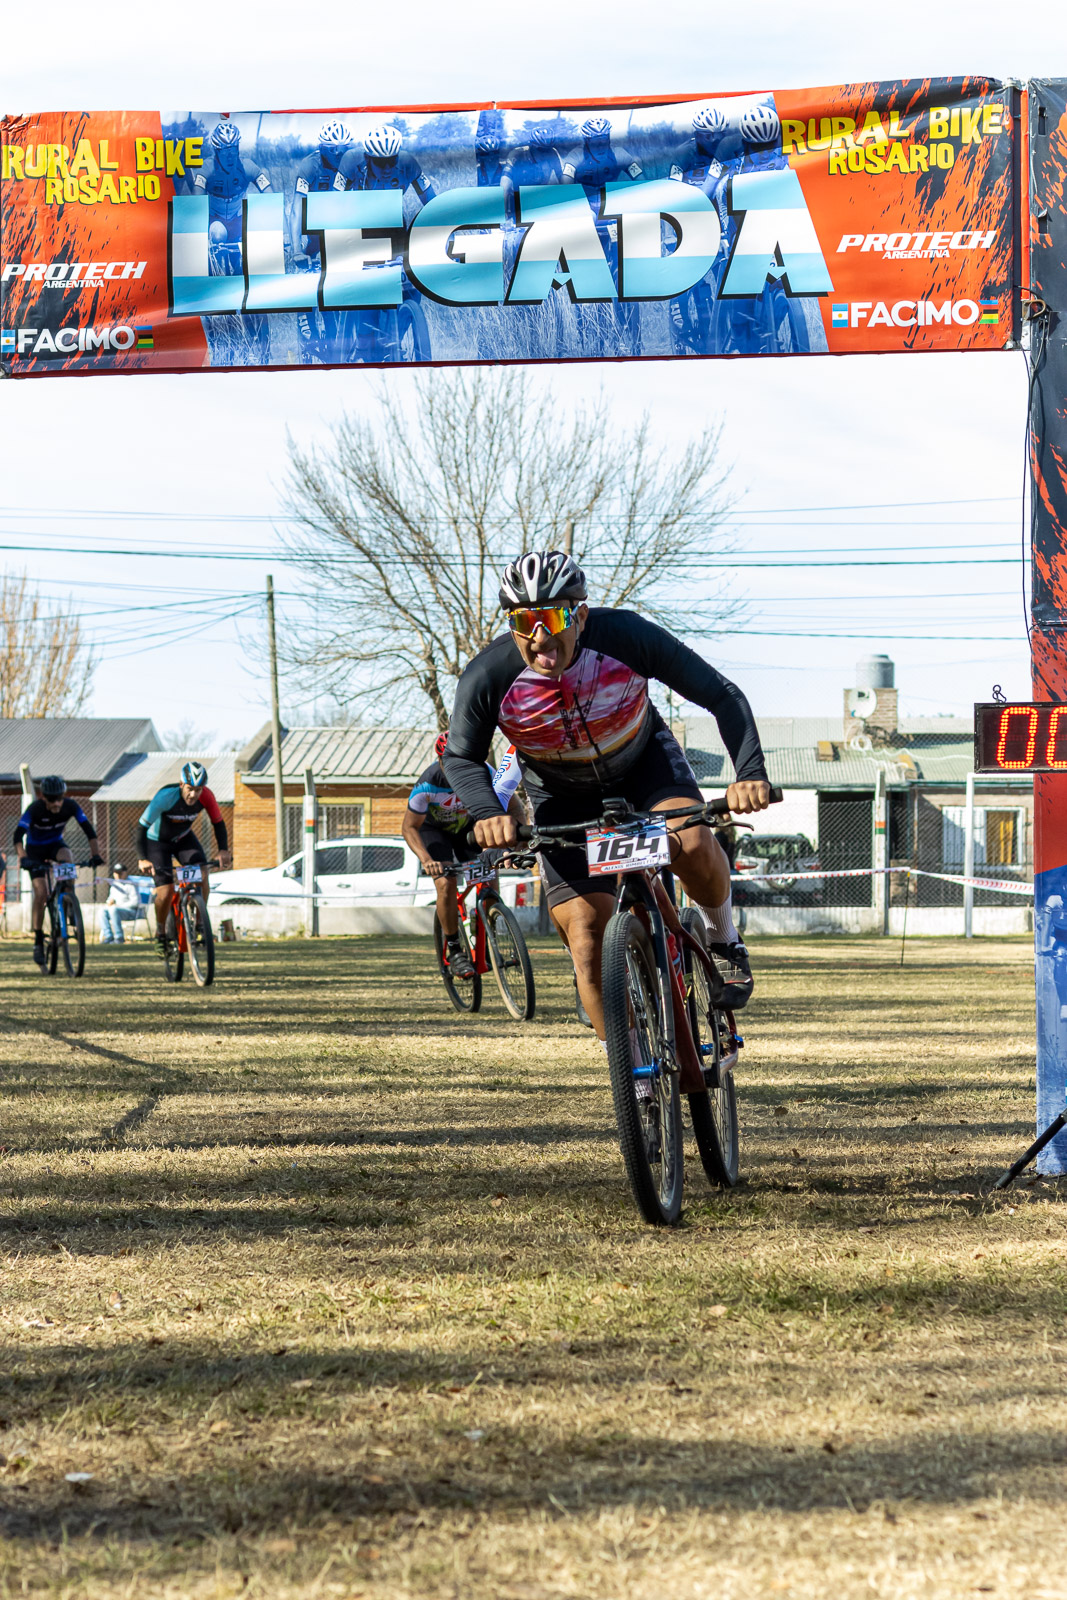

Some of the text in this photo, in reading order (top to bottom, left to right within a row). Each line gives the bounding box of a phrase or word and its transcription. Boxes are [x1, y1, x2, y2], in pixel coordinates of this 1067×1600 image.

[781, 104, 1004, 155] RURAL BIKE
[1, 137, 204, 180] RURAL BIKE
[828, 142, 955, 175] ROSARIO
[45, 174, 161, 205] ROSARIO
[168, 169, 835, 317] LLEGADA
[836, 230, 997, 253] PROTECH
[882, 249, 951, 260] ARGENTINA
[1, 261, 148, 281] PROTECH
[41, 279, 105, 289] ARGENTINA
[851, 301, 979, 328] FACIMO
[17, 325, 135, 353] FACIMO
[597, 833, 660, 862] 164
[183, 869, 197, 879] 87
